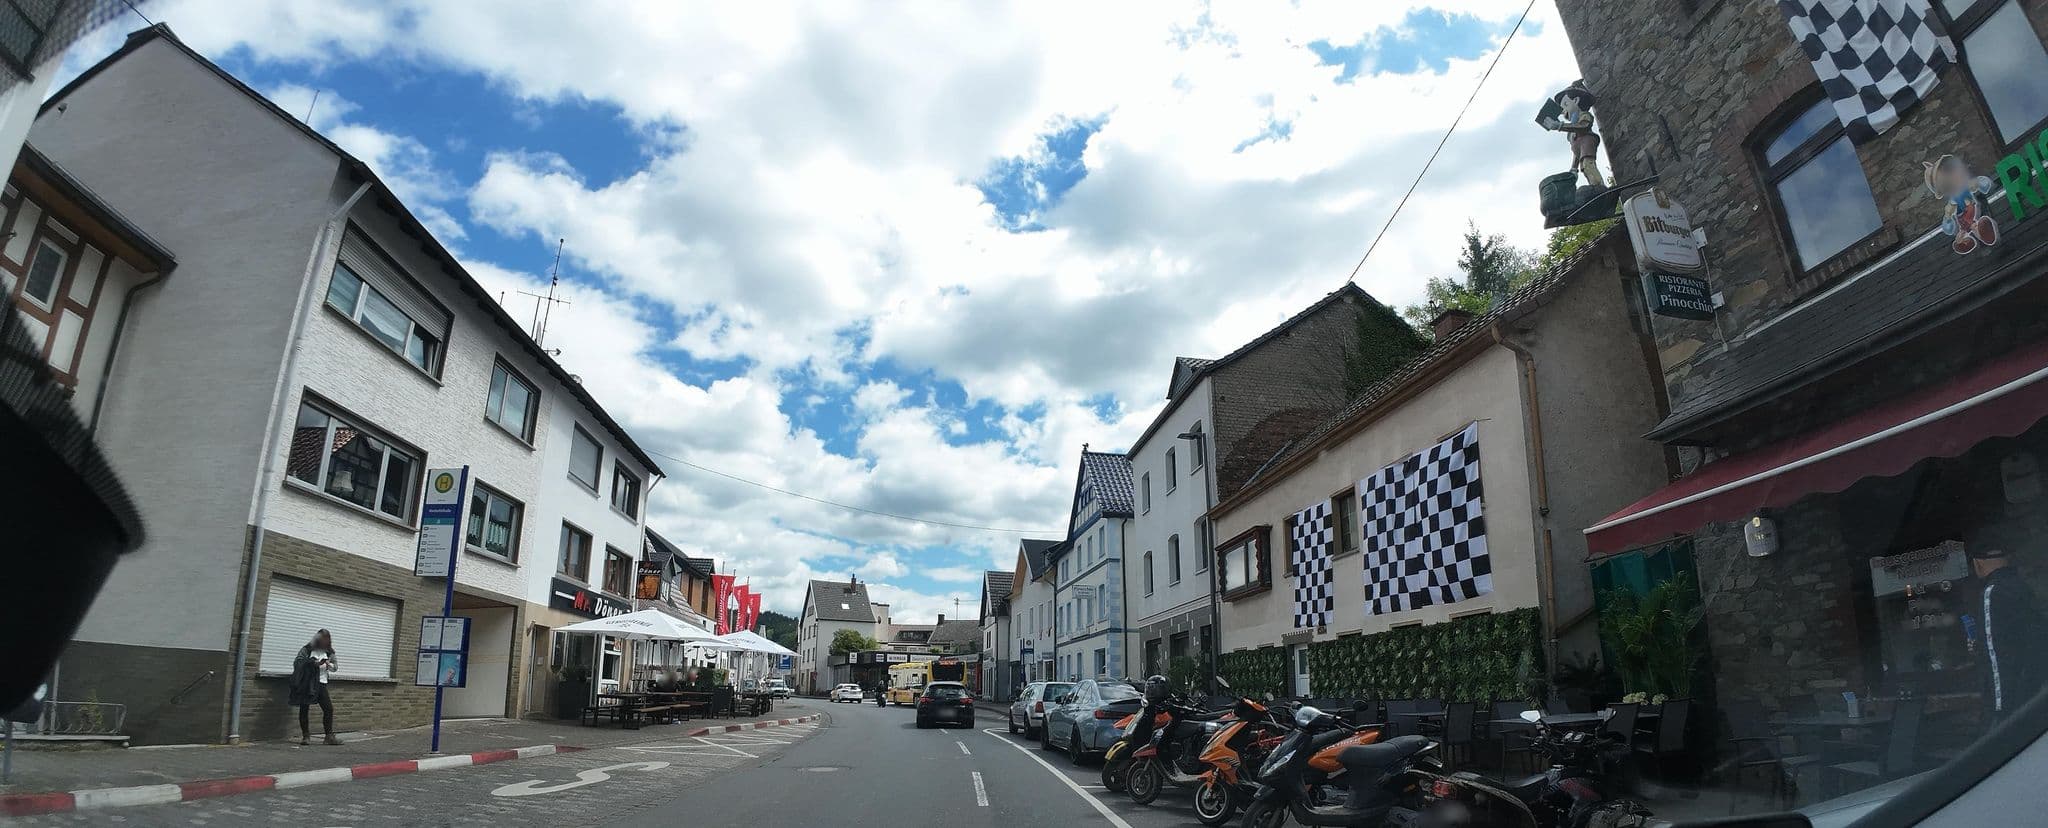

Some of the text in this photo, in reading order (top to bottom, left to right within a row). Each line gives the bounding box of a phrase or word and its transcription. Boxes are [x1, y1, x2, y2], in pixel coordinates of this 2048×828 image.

[1659, 275, 1706, 290] RISTORANTE
[1668, 284, 1704, 298] PIZZERIA
[1660, 294, 1714, 314] Pinocchio
